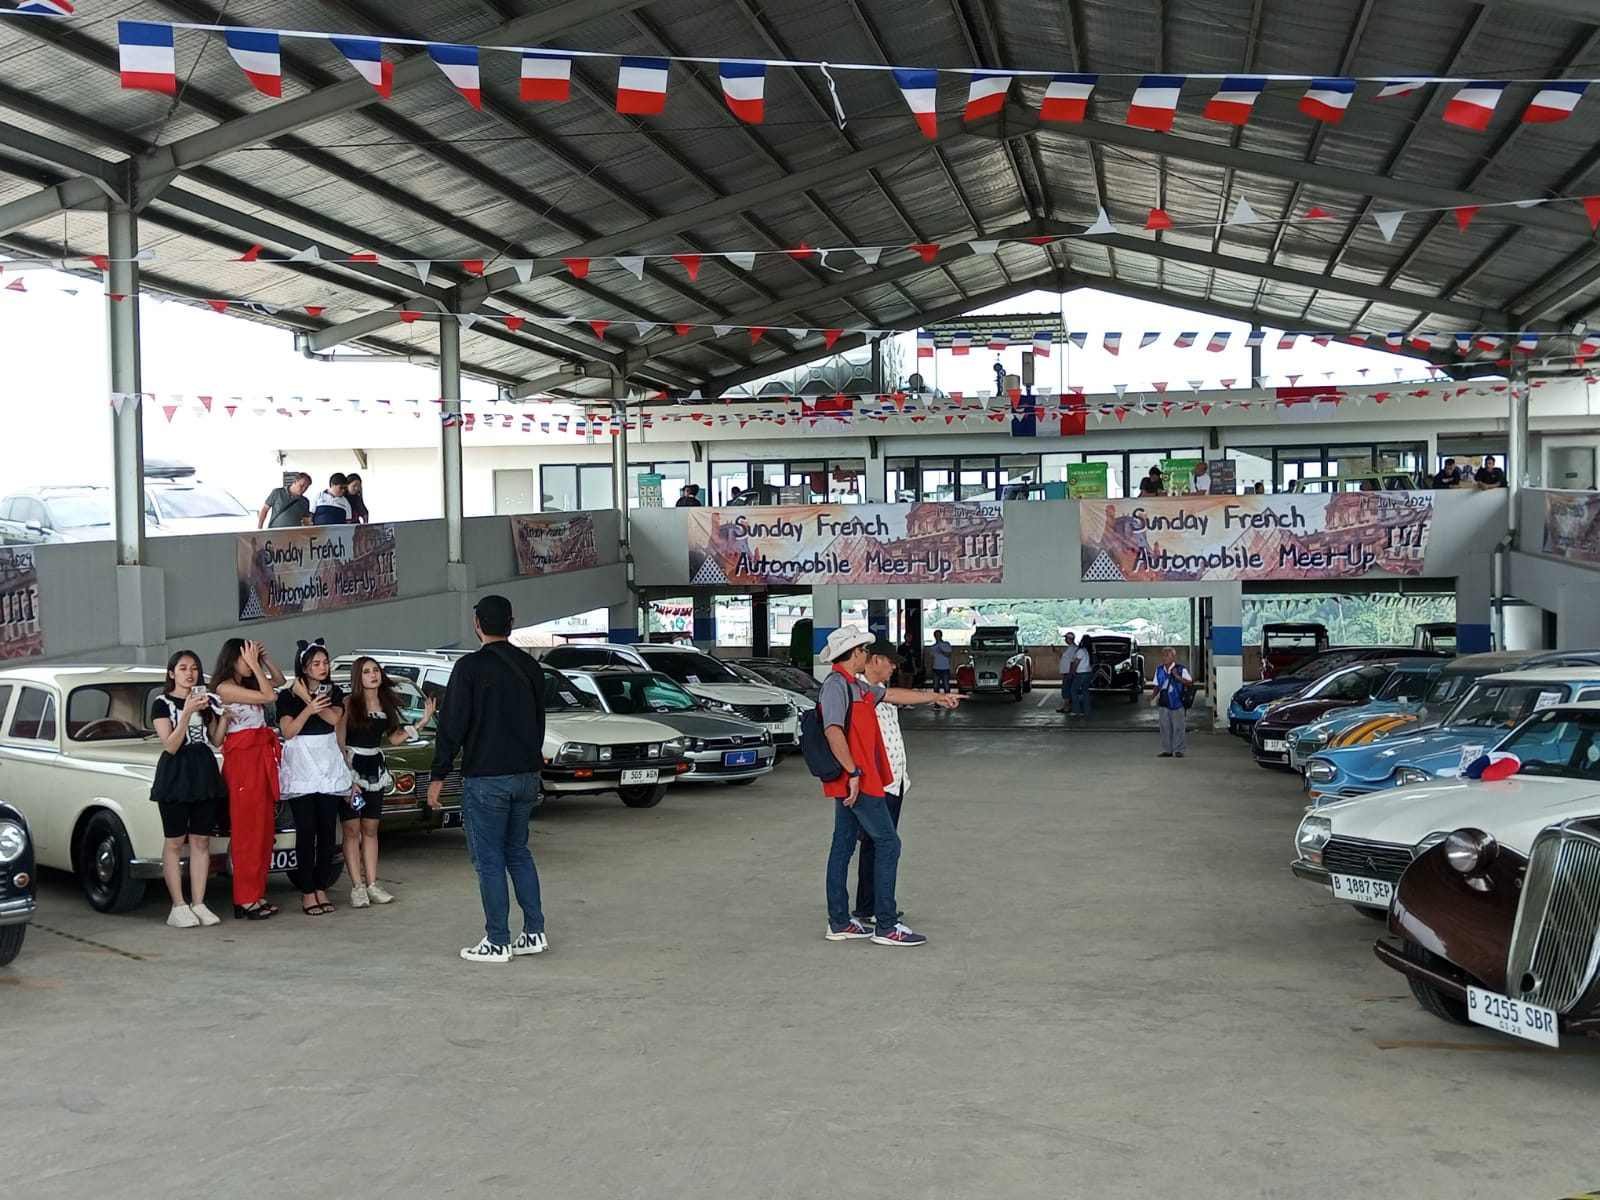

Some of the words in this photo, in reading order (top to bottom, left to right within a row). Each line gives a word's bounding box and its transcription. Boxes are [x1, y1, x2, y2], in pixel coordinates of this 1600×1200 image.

[975, 505, 1001, 517] 2024
[1404, 495, 1432, 508] 2024
[734, 515, 803, 541] Sunday
[817, 513, 889, 536] French
[1132, 507, 1208, 535] Sunday
[1224, 505, 1306, 529] French
[264, 540, 303, 567] Sunday
[309, 536, 346, 561] French
[735, 551, 851, 574] Automobile
[865, 550, 953, 577] Meet-Up
[1133, 545, 1264, 570] Automobile
[1279, 543, 1376, 569] Meet-Up
[268, 575, 329, 606] Automobile
[335, 570, 376, 597] Meet-Up
[1334, 875, 1341, 889] B
[1346, 877, 1370, 894] 1887
[1372, 881, 1390, 898] SEP
[1469, 989, 1477, 1009] B
[1484, 994, 1519, 1022] 2155
[1525, 1007, 1553, 1033] SBR
